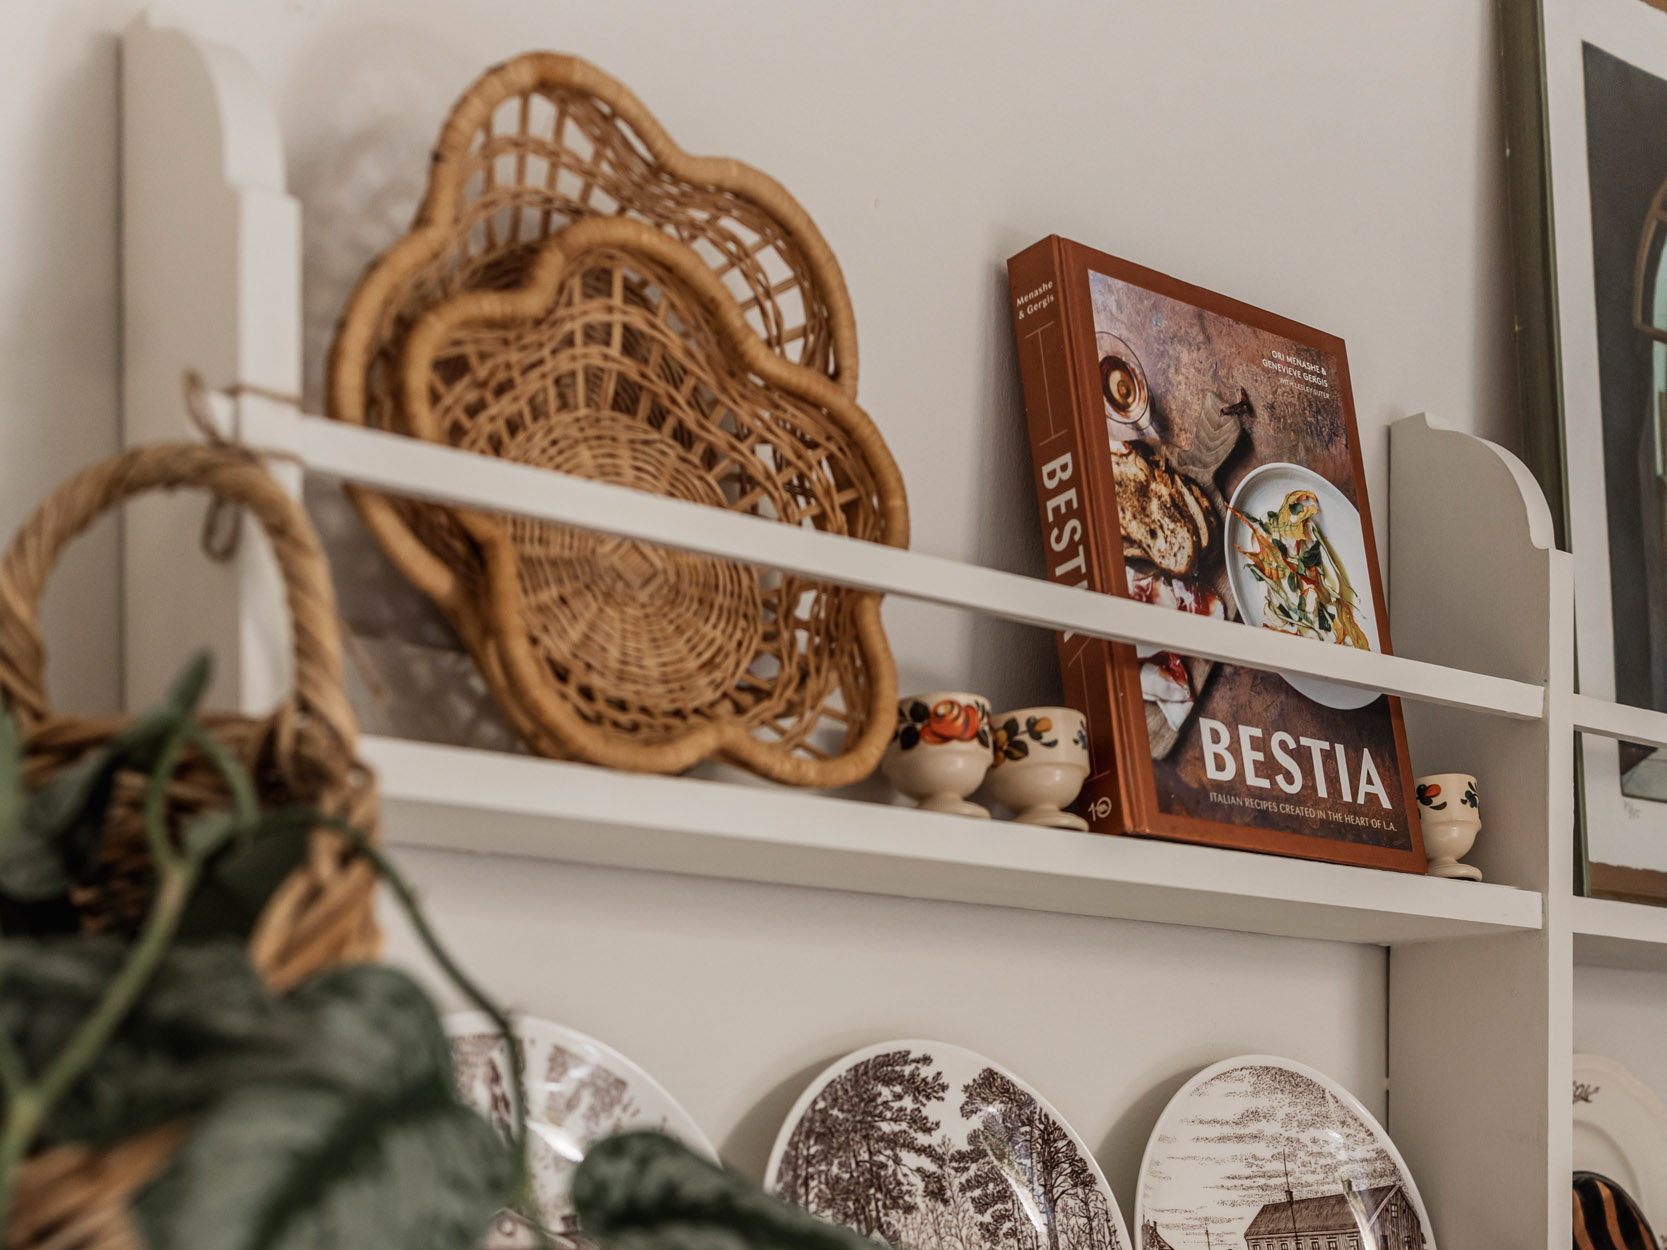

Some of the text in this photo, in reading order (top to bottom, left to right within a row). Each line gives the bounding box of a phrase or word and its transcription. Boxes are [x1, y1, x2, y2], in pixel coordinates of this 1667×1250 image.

[1016, 281, 1053, 307] Menashe
[1018, 294, 1055, 320] & Gergis
[1262, 358, 1328, 388] GENEVIEVE GERGIS
[1271, 350, 1327, 376] ORI MENASHE &
[1041, 451, 1089, 643] BEST
[1198, 717, 1392, 810] BESTIA
[1209, 791, 1398, 832] ITALIAN RECIPES CREATED IN THE HEART OF L.A.
